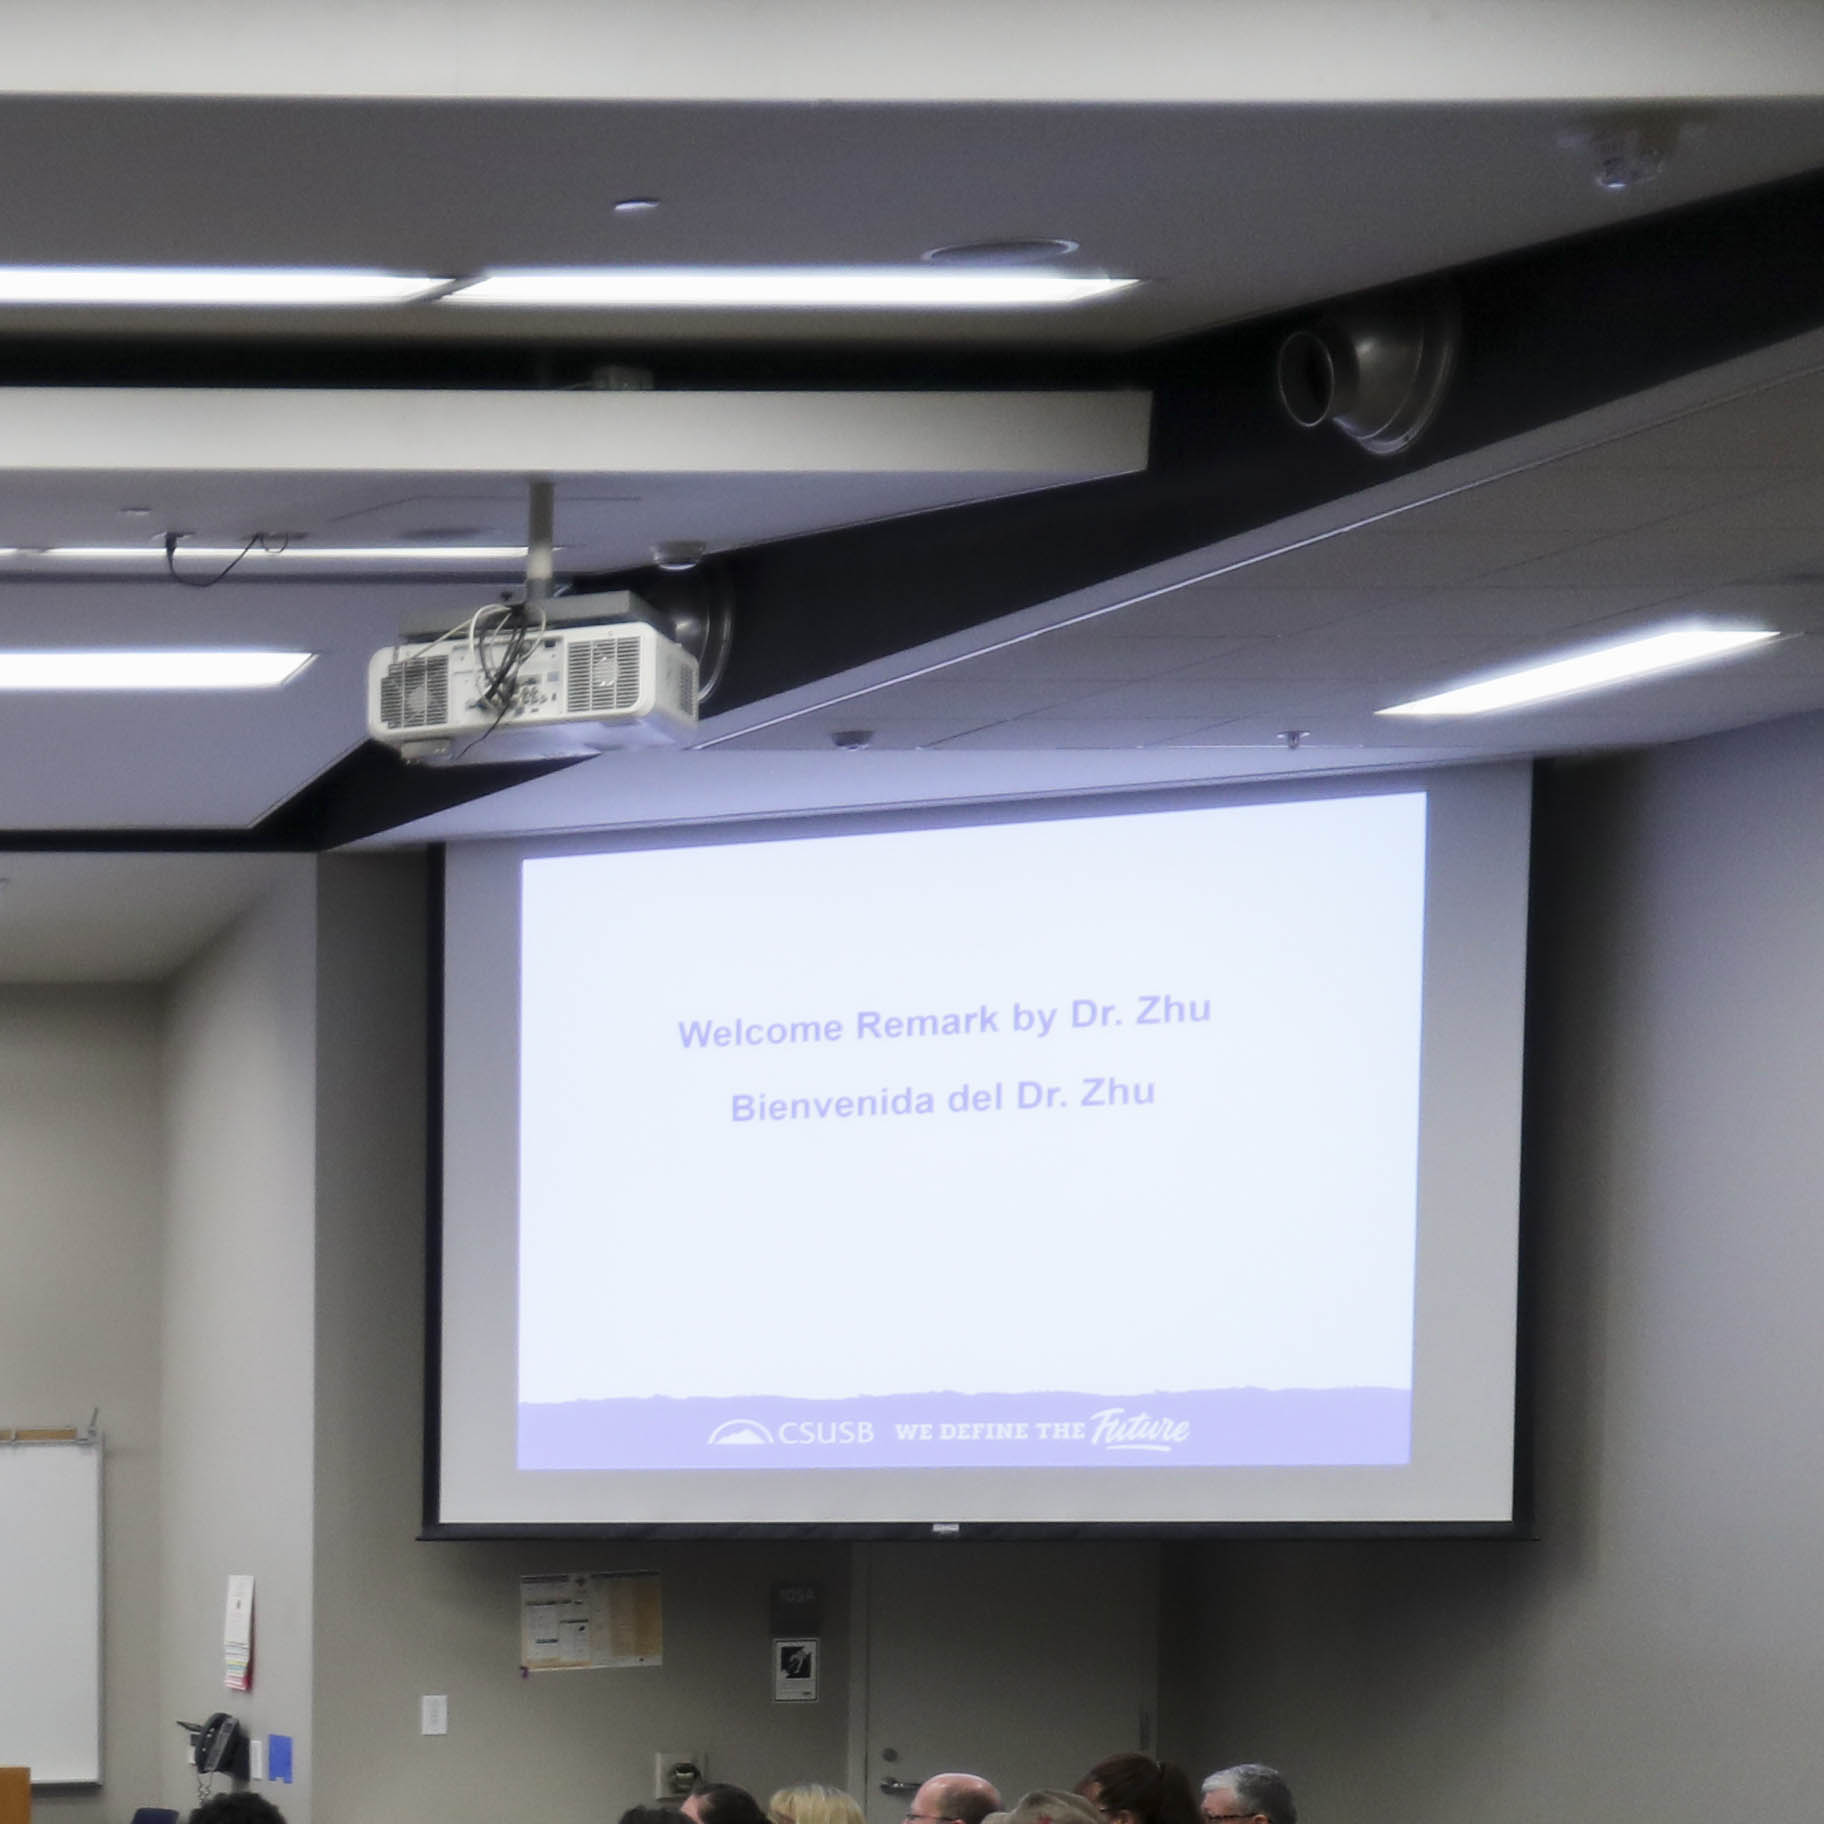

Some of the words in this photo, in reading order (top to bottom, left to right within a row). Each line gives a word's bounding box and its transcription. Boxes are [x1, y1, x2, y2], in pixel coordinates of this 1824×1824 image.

[678, 1018, 844, 1050] Welcome
[856, 1005, 1000, 1042] Remark
[1013, 1003, 1059, 1040] by
[1071, 999, 1124, 1030] Dr.
[1136, 994, 1212, 1026] Zhu
[731, 1083, 936, 1124] Bienvenida
[948, 1082, 1004, 1114] del
[1017, 1080, 1069, 1111] Dr.
[1081, 1076, 1156, 1108] Zhu
[778, 1421, 876, 1446] CSUSB
[894, 1423, 934, 1442] WE
[940, 1422, 1030, 1442] DEFINE
[1036, 1421, 1087, 1441] THE
[1089, 1407, 1192, 1448] Future
